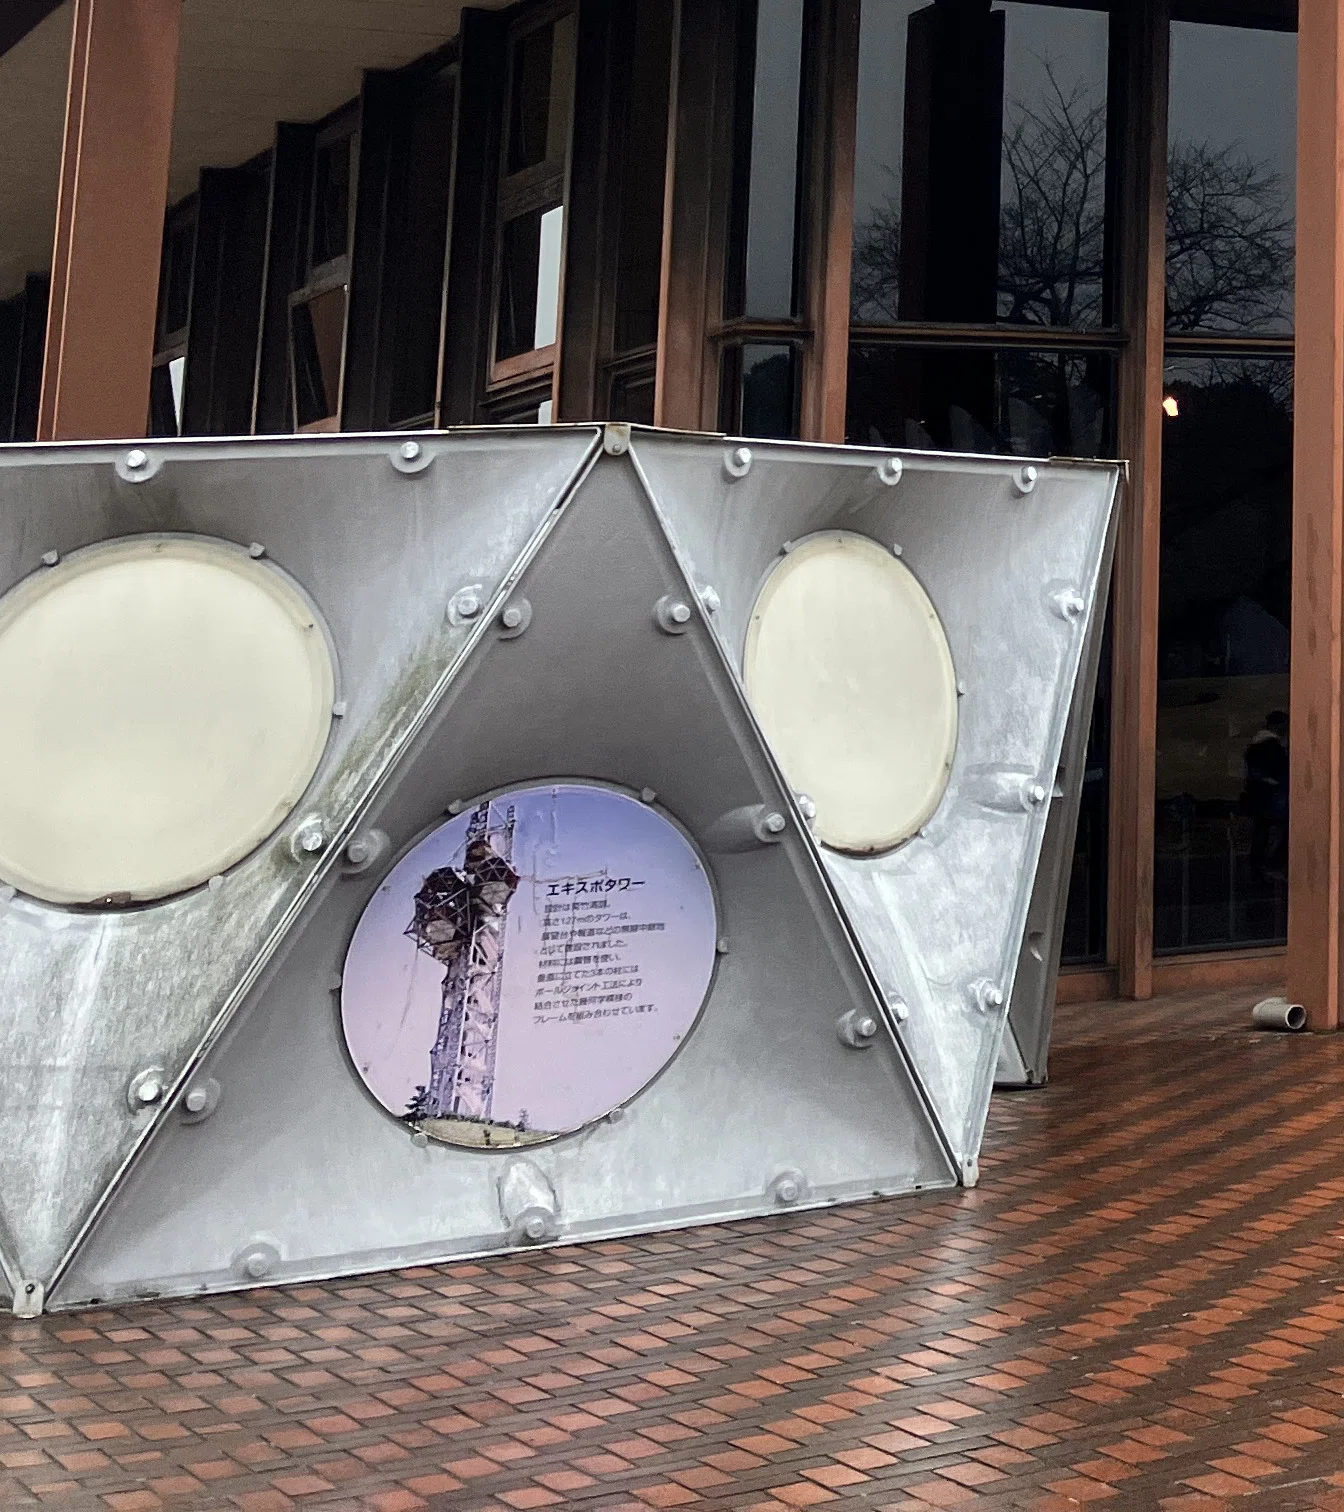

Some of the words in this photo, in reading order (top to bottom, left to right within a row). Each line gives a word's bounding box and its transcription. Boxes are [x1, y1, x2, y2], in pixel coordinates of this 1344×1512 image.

[546, 878, 646, 896] エキスポタワー
